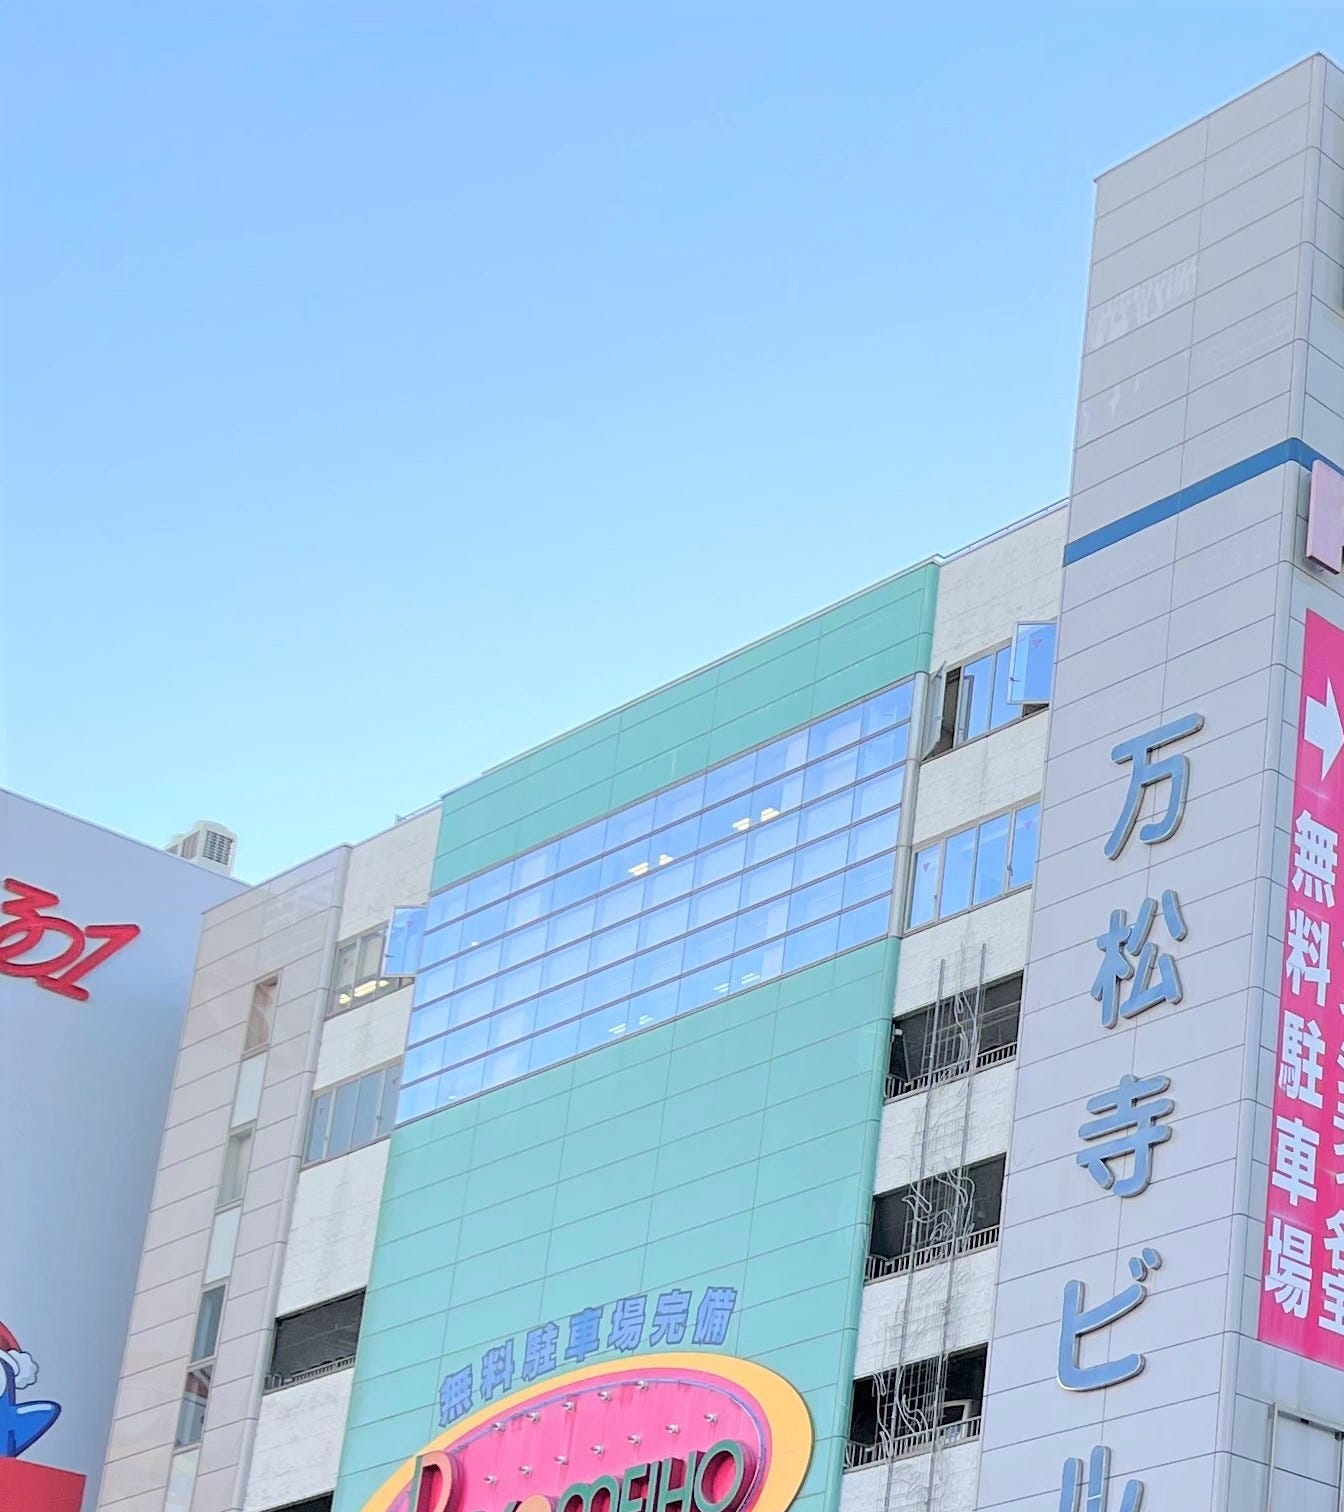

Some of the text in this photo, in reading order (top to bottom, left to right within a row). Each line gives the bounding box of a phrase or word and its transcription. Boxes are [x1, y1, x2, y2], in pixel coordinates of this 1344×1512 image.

[1263, 808, 1340, 1322] 無料駐車場
[439, 1286, 737, 1426] 無料駐車場完備
